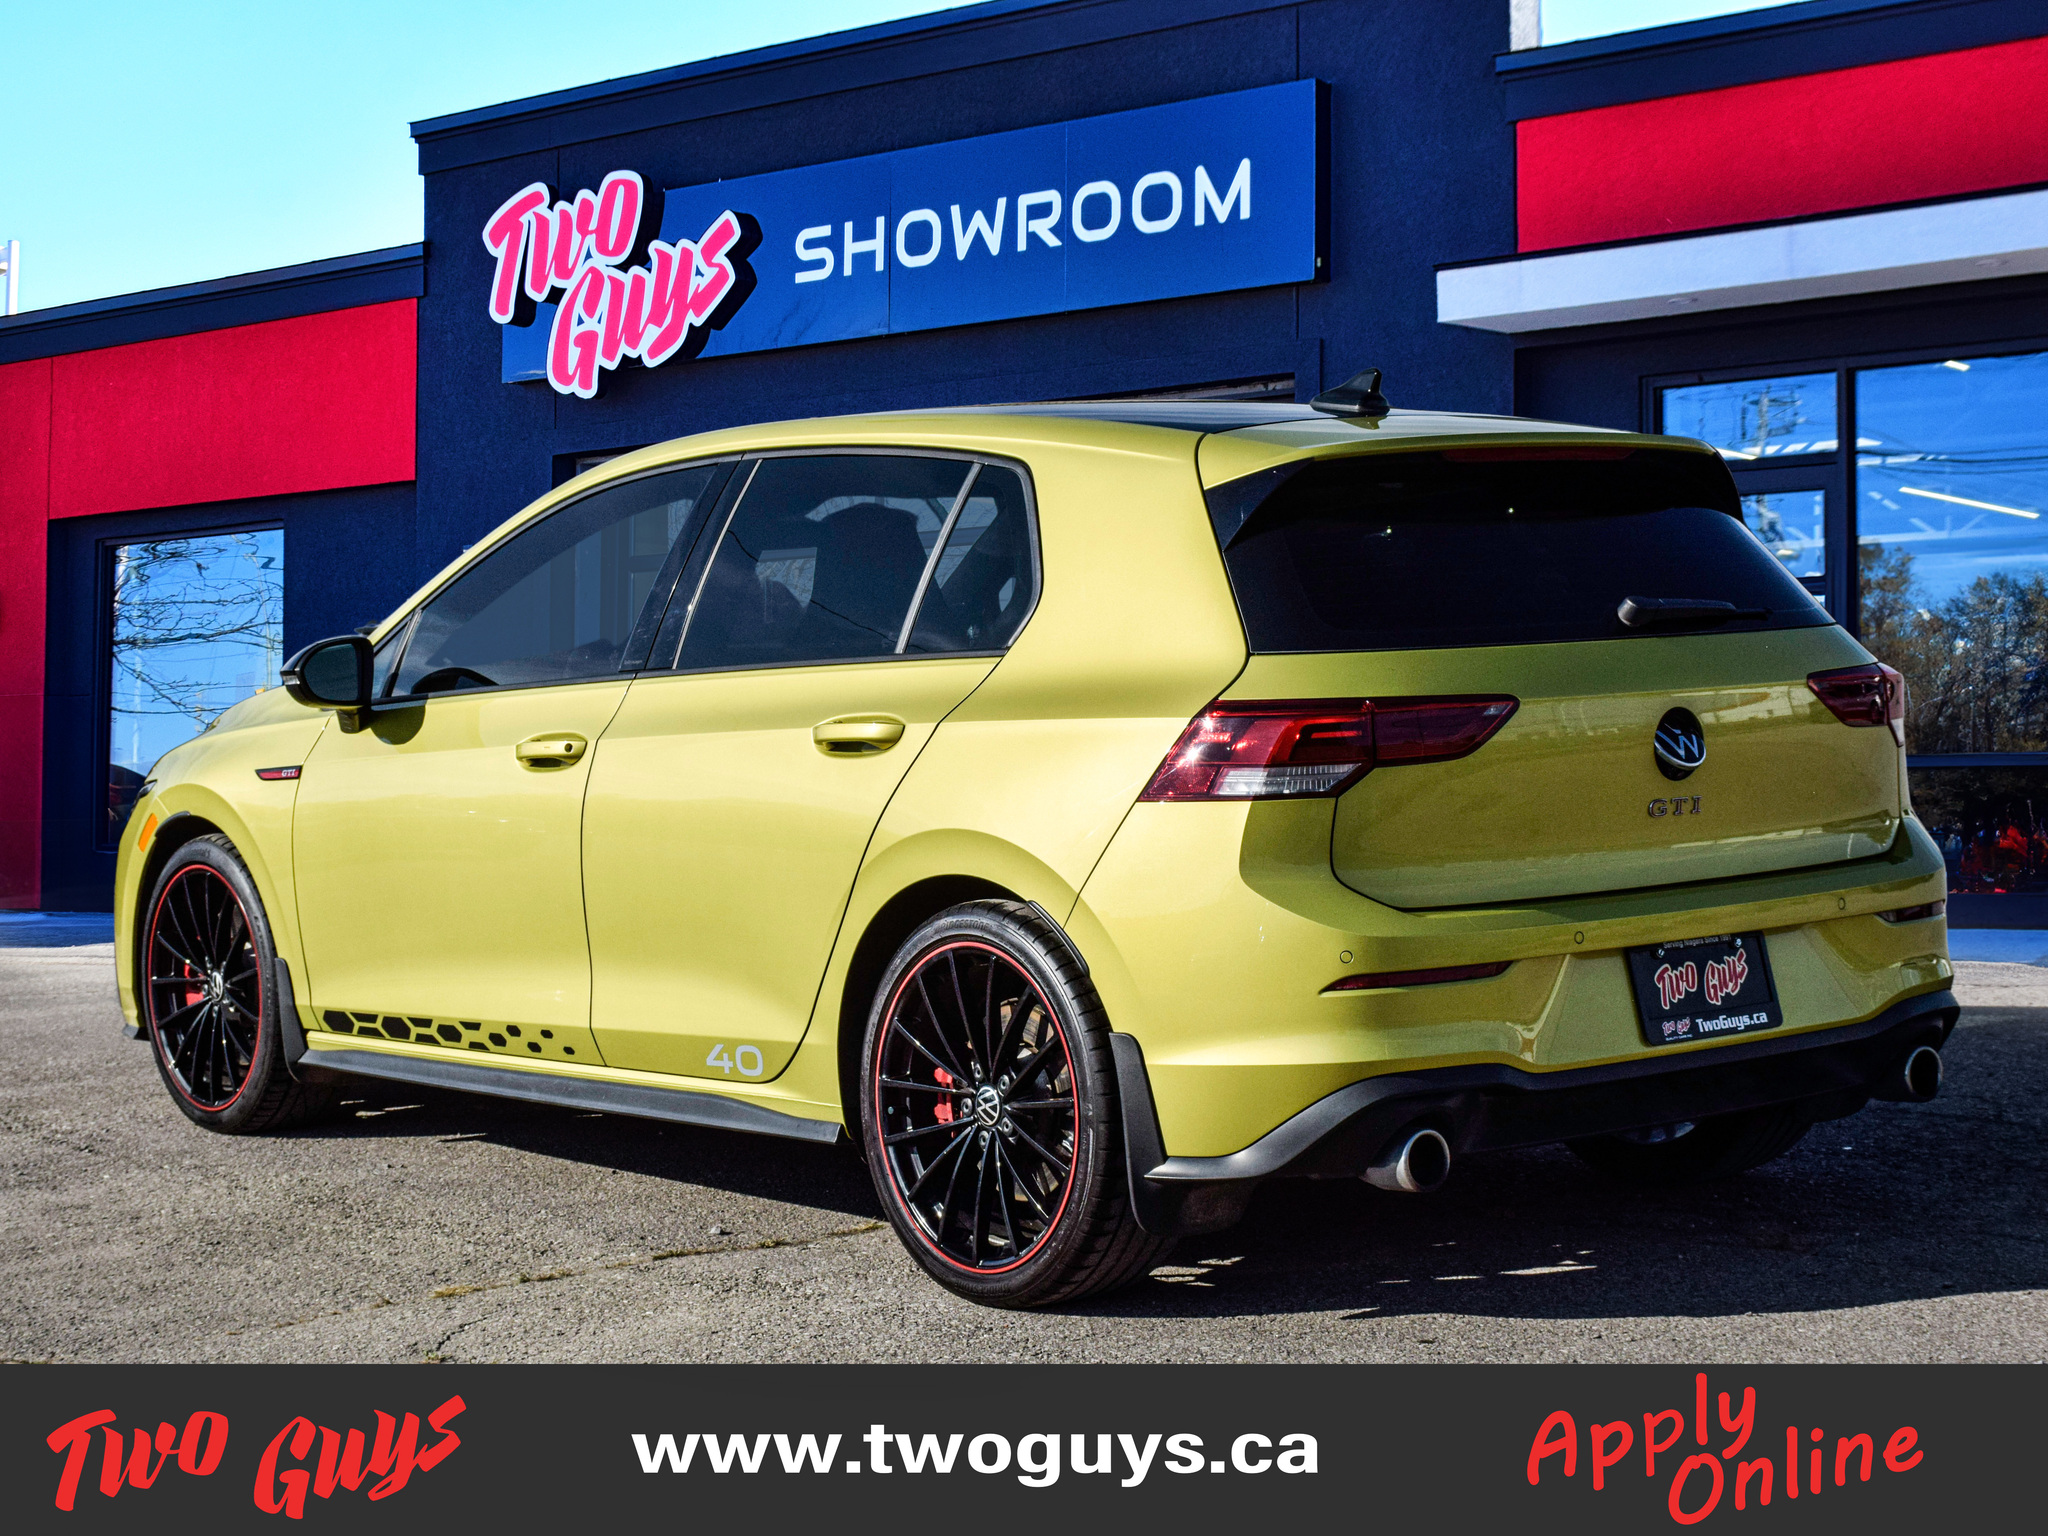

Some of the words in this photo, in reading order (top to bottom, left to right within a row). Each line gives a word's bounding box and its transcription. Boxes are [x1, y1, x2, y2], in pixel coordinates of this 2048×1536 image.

[795, 158, 1251, 284] SHOWROOM
[281, 768, 297, 778] GTI
[1648, 795, 1703, 818] GTI
[1695, 1012, 1769, 1033] TwoGuys.ca
[705, 1043, 764, 1077] 40
